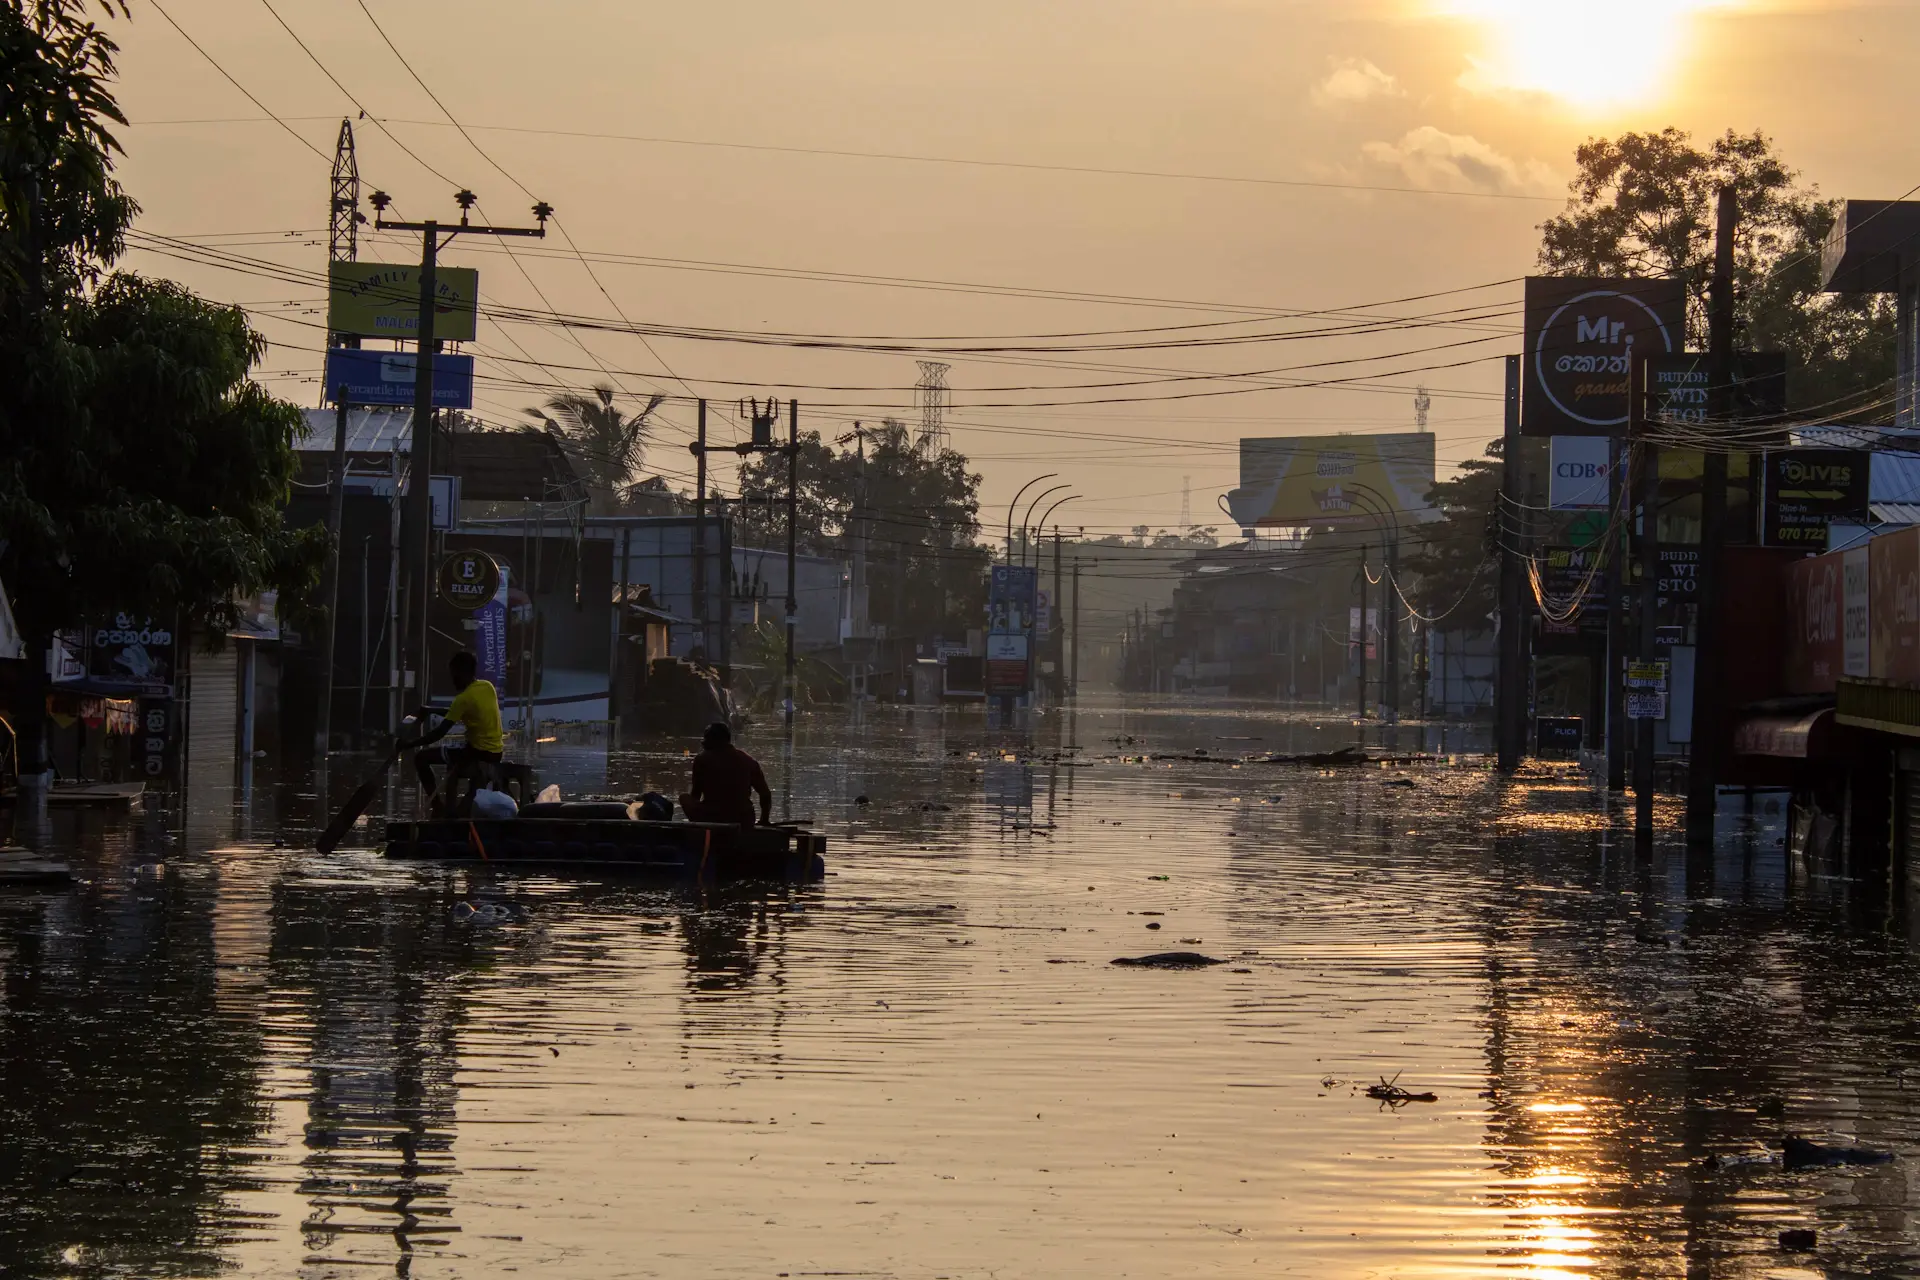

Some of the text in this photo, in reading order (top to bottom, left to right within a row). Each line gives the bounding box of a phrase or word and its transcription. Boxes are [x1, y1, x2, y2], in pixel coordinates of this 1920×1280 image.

[350, 271, 408, 297] FAMILY
[1577, 315, 1635, 344] Mr.
[339, 383, 394, 397] ercantile
[1573, 376, 1631, 402] grand
[1557, 463, 1595, 478] CDB
[1785, 463, 1852, 482] OLIVES
[1778, 527, 1827, 541] 070 722
[1660, 551, 1700, 561] BUDD
[463, 561, 475, 578] E
[1669, 564, 1699, 577] WI
[451, 584, 485, 595] ELKAY
[1658, 578, 1697, 592] STO
[483, 610, 496, 673] Mercantile
[496, 607, 507, 681] Investments
[1655, 636, 1681, 645] FLICK
